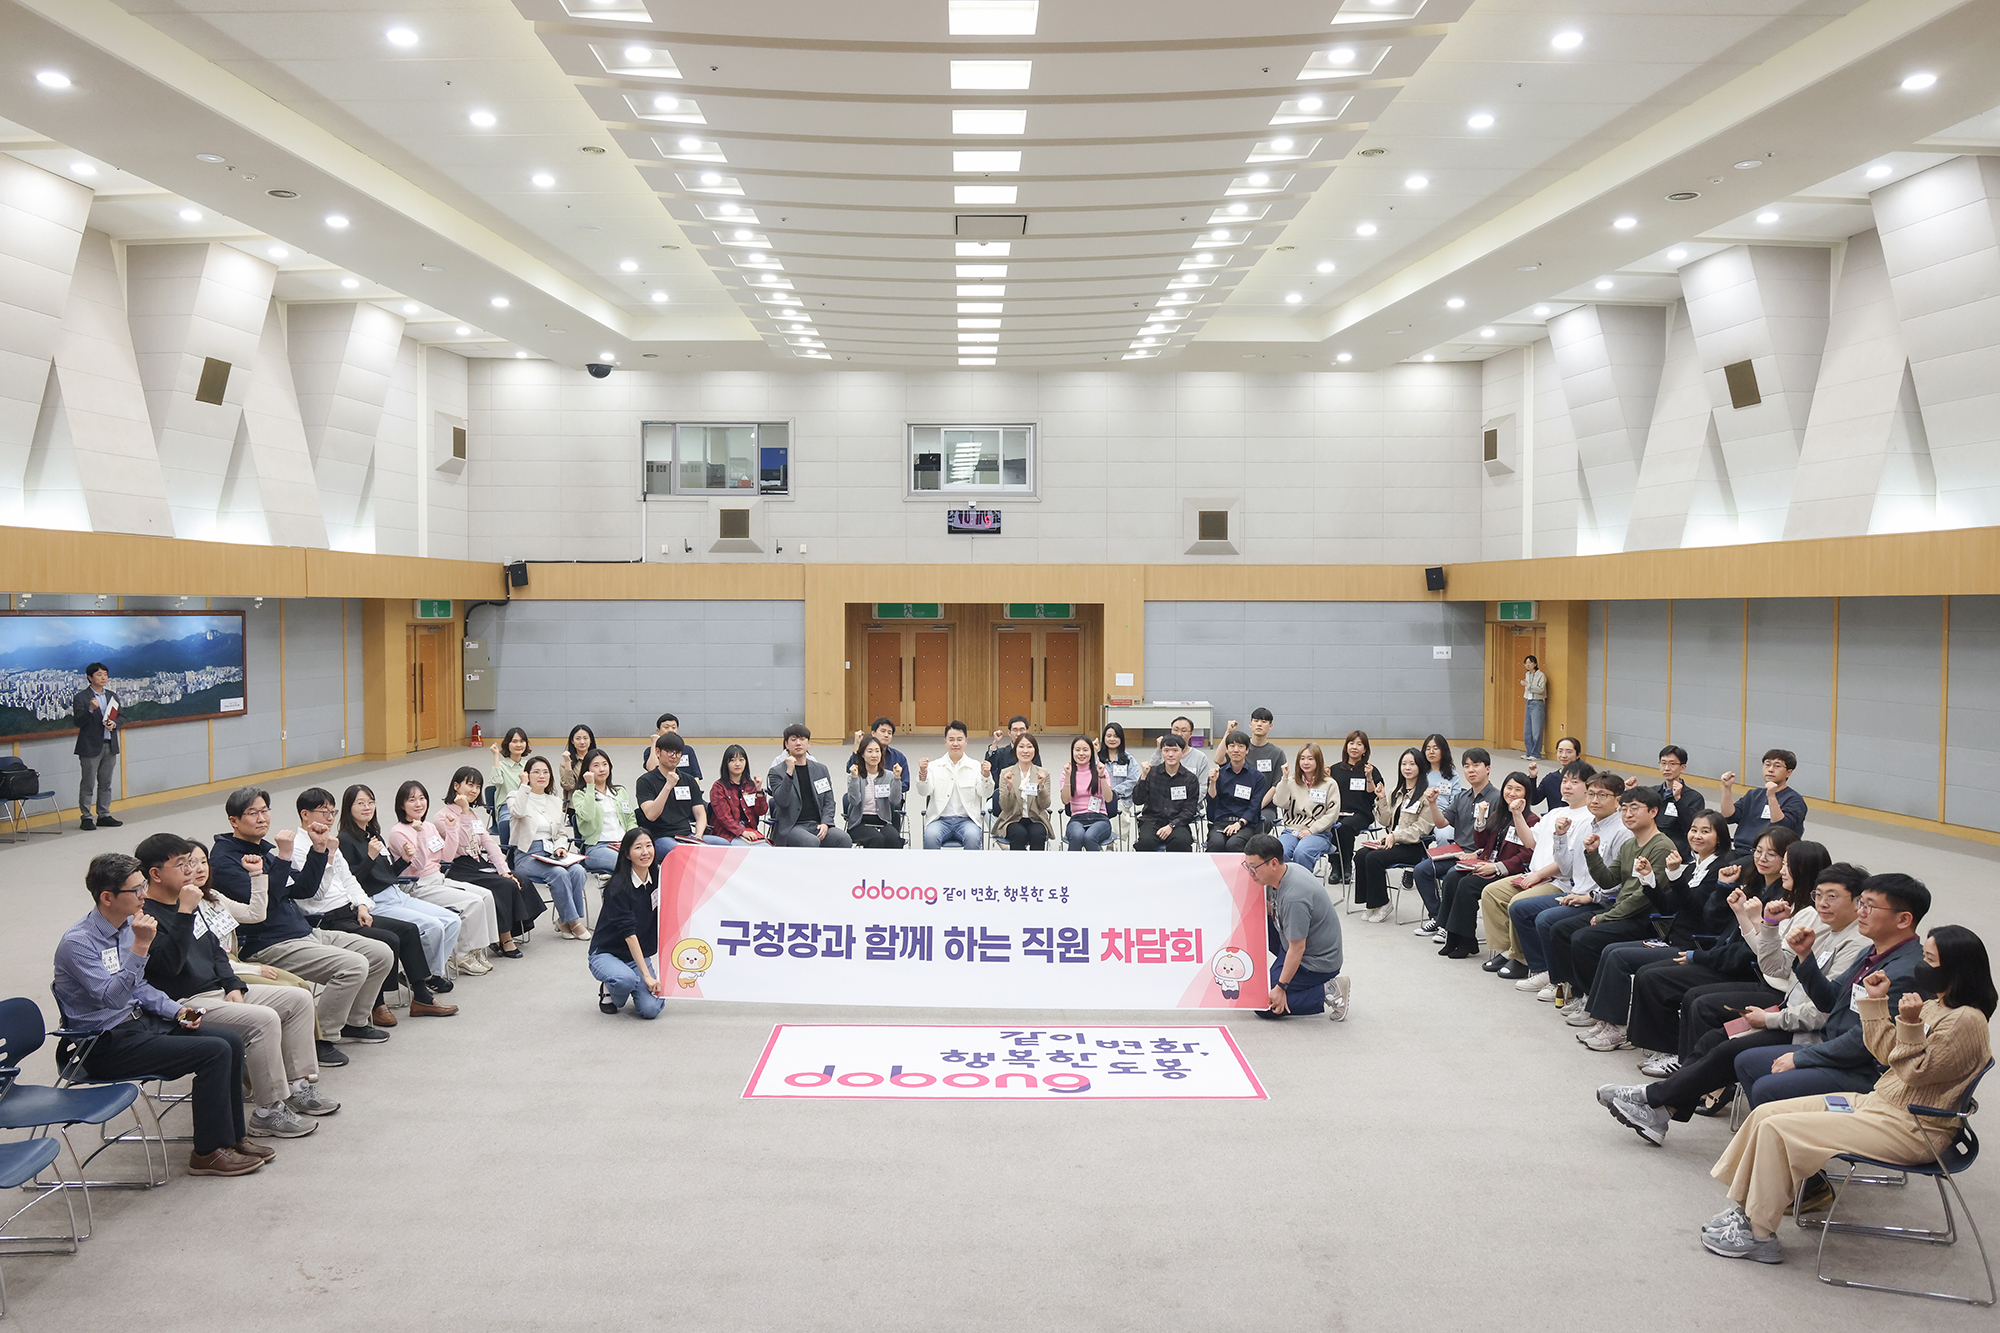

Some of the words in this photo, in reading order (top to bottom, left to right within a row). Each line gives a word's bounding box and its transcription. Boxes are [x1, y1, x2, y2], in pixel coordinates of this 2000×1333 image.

[851, 878, 938, 905] dobong
[942, 887, 966, 902] 같이
[970, 886, 1000, 903] 변화,
[1003, 886, 1044, 903] 행복한
[1048, 886, 1070, 904] 도봉
[716, 920, 857, 961] 구청장과
[864, 924, 934, 962] 함께
[943, 926, 1013, 963] 하는
[1021, 926, 1091, 964] 직원
[1099, 927, 1204, 964] 차담회
[999, 1031, 1086, 1046] 같이
[1095, 1037, 1210, 1057] 변화,
[939, 1049, 1098, 1069] 행복한
[1107, 1058, 1192, 1080] 도봉
[783, 1065, 1092, 1094] dobong
